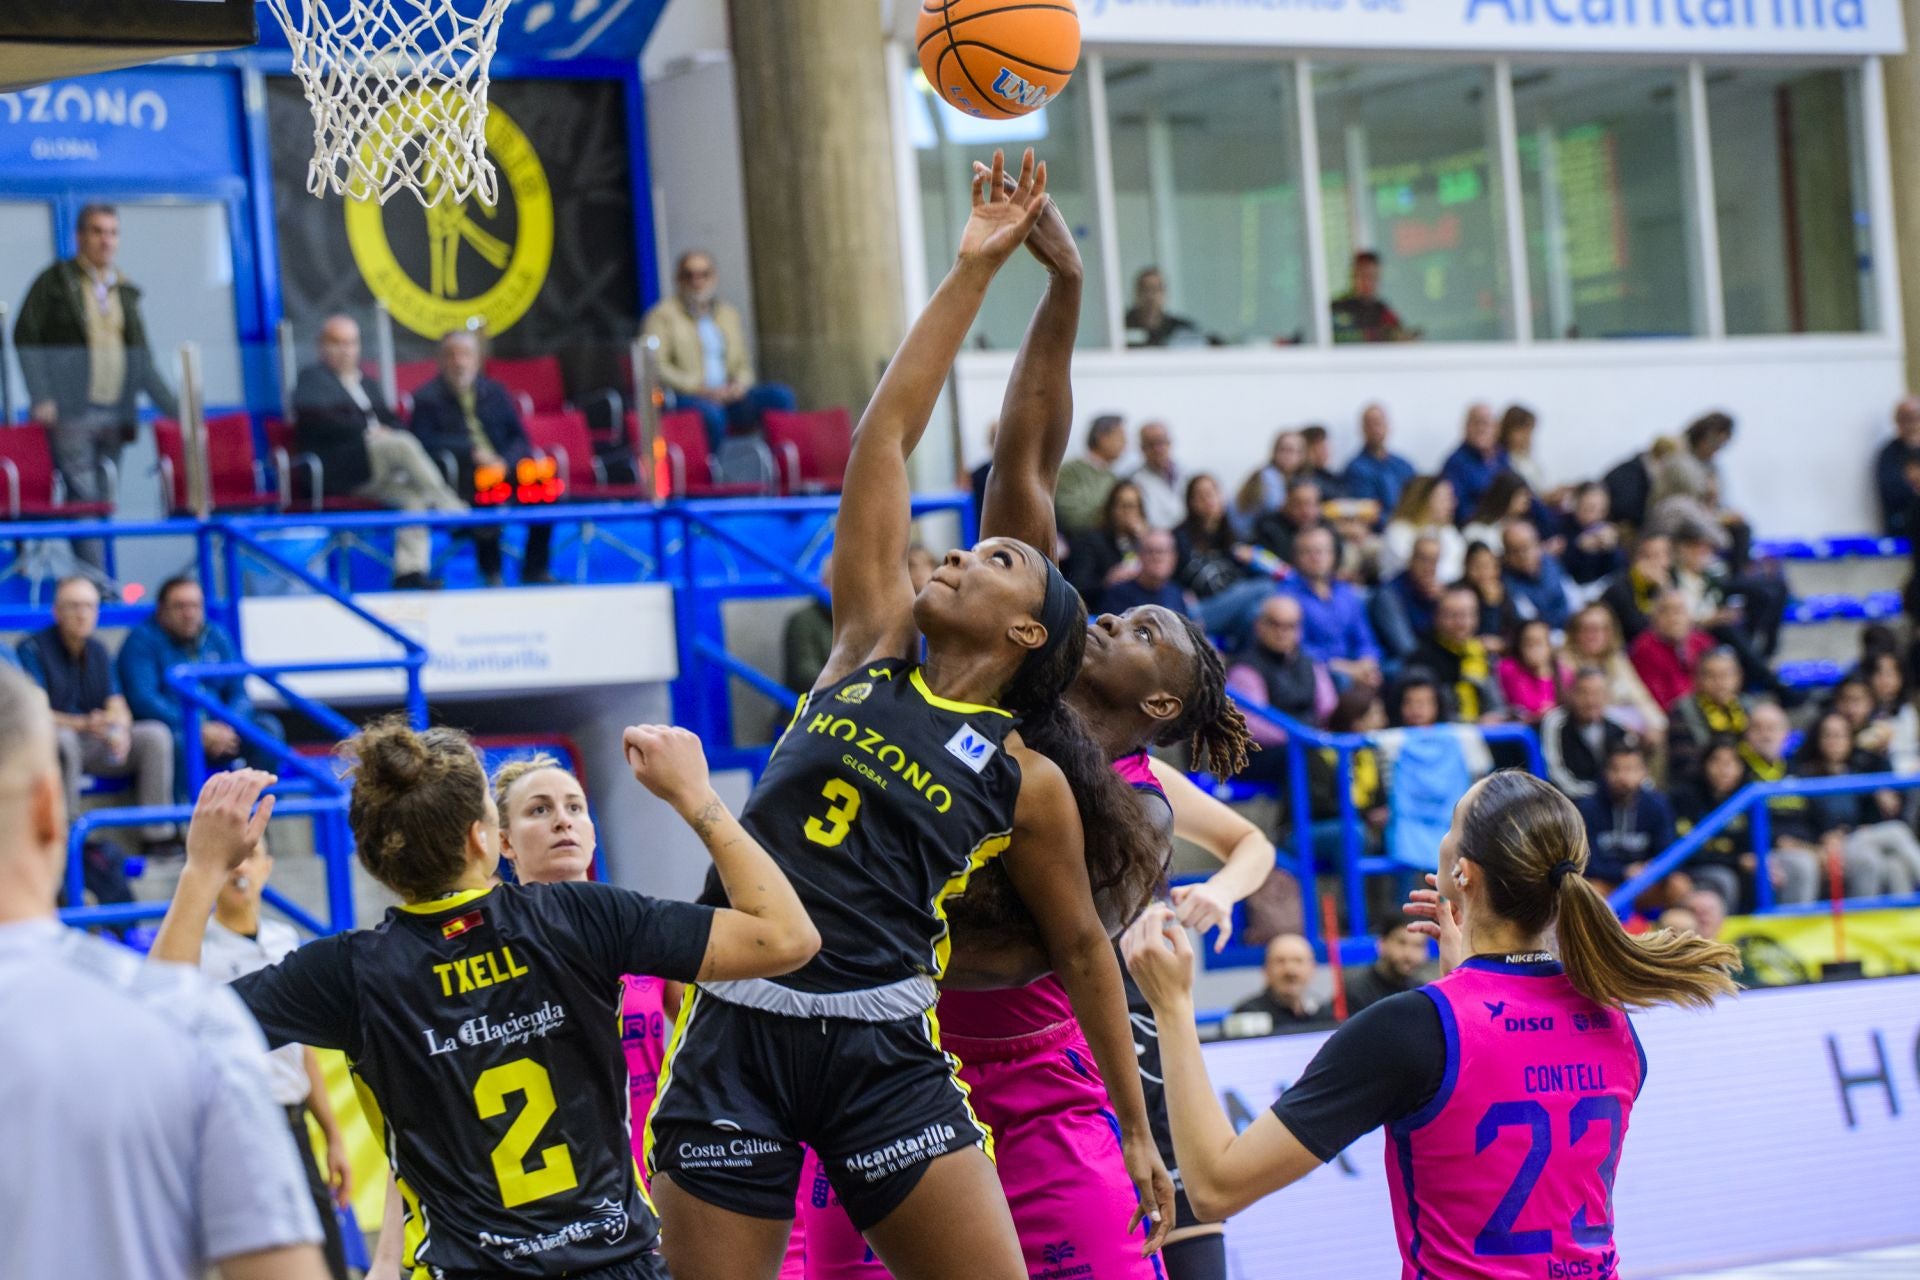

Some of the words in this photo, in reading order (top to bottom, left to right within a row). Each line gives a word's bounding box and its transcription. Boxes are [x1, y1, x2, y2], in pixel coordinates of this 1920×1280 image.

[807, 712, 952, 814] HOZONO
[842, 753, 889, 791] GLOBAL
[804, 777, 861, 847] 3
[432, 946, 529, 997] TXELL
[1505, 953, 1535, 964] NIKE
[422, 1028, 459, 1056] La
[458, 1001, 566, 1047] Hacienda
[1524, 1063, 1606, 1093] CONTELL
[1827, 1027, 1920, 1129] H
[473, 1057, 578, 1208] 2
[679, 1142, 727, 1159] Costa
[729, 1137, 782, 1156] Cálida
[846, 1123, 956, 1173] Alcantarilla
[1474, 1095, 1622, 1256] 23
[1547, 1259, 1593, 1280] Islas
